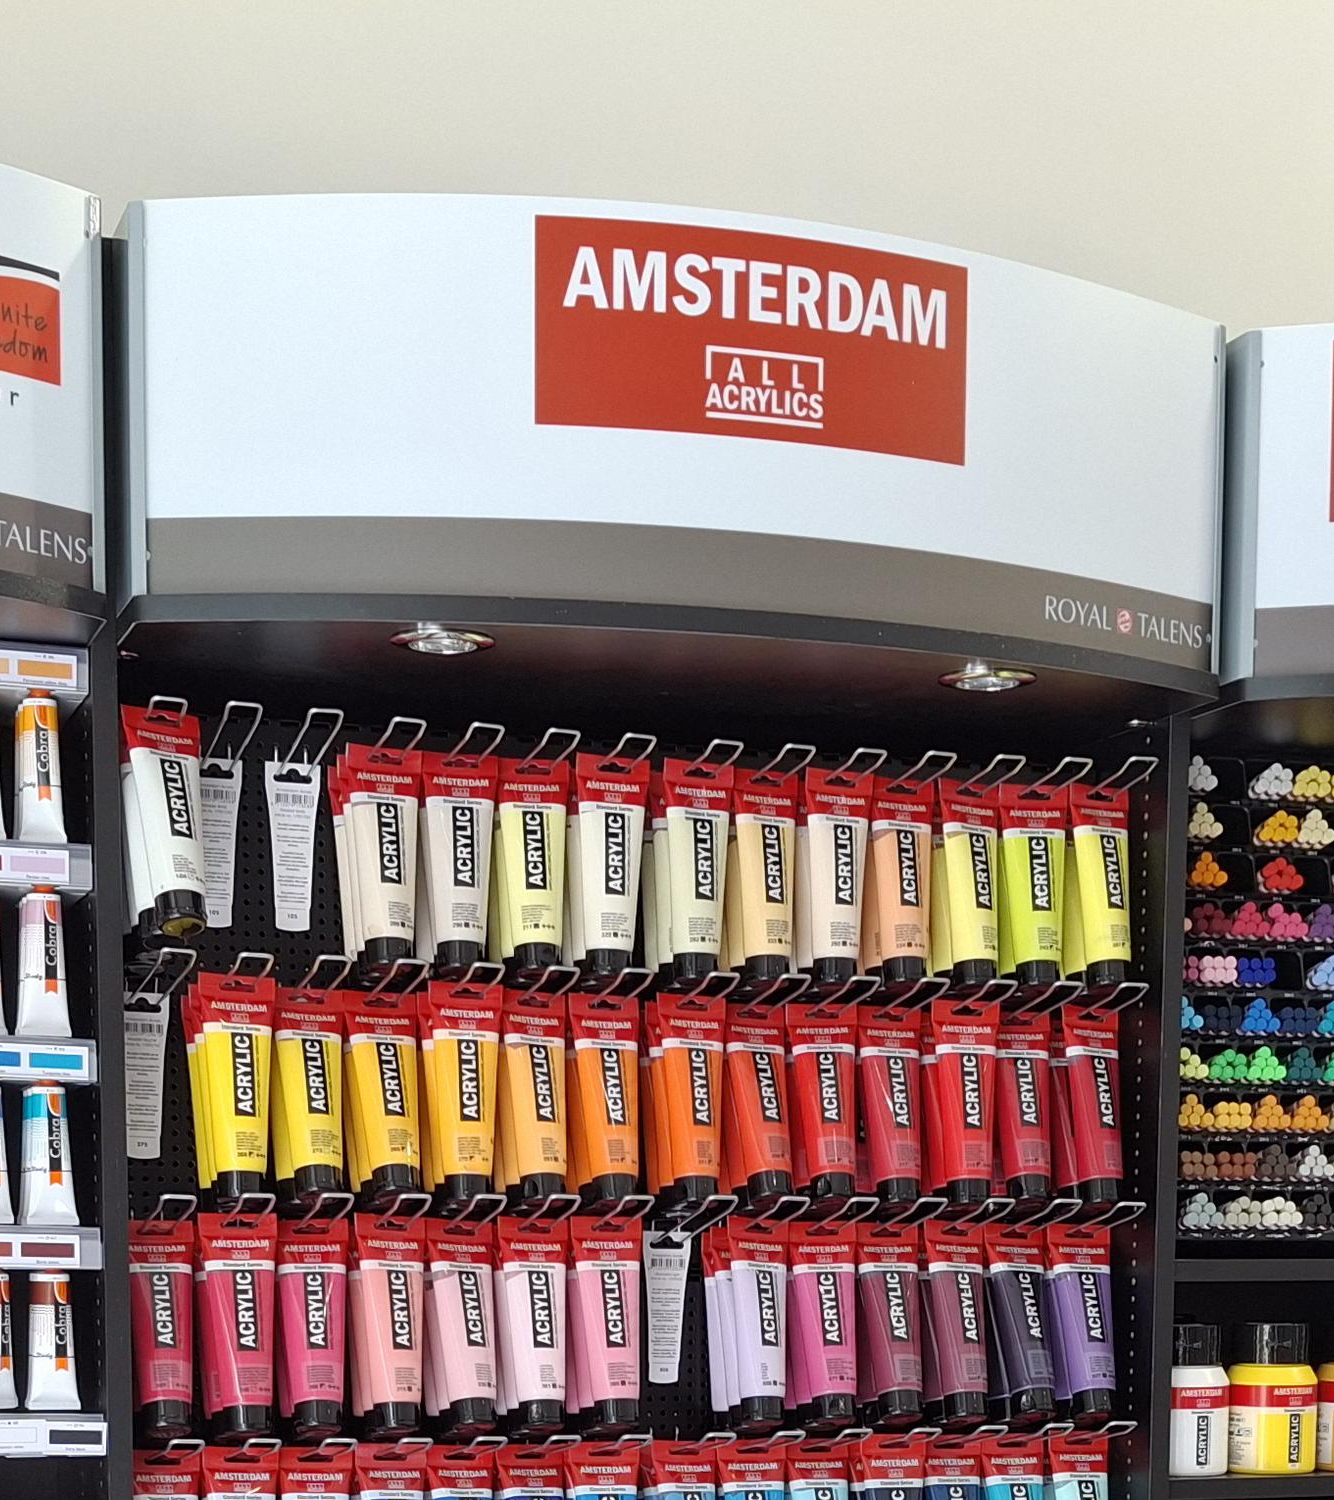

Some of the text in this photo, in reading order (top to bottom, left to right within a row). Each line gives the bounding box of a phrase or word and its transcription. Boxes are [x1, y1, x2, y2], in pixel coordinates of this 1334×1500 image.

[563, 246, 948, 350] AMSTERDAM
[706, 380, 825, 421] ACRYLICS
[727, 353, 810, 390] ALL
[1044, 596, 1204, 648] ROYAL TALENS
[165, 760, 190, 837] ACRYLIC
[356, 773, 413, 785] AMSTERDAM
[585, 779, 641, 792] AMSTERDAM
[380, 804, 399, 883] ACRYLIC
[1034, 837, 1049, 910] ACRYLIC
[234, 1033, 256, 1116] ACRYLIC
[694, 1049, 711, 1125] ACRYLIC
[156, 1273, 176, 1347] ACRYLIC
[393, 1272, 411, 1348] ACRYLIC
[1088, 1273, 1103, 1340] ACRYLIC
[1197, 1417, 1207, 1466] ACRYLIC
[287, 1472, 343, 1484] AMSTERDAM
